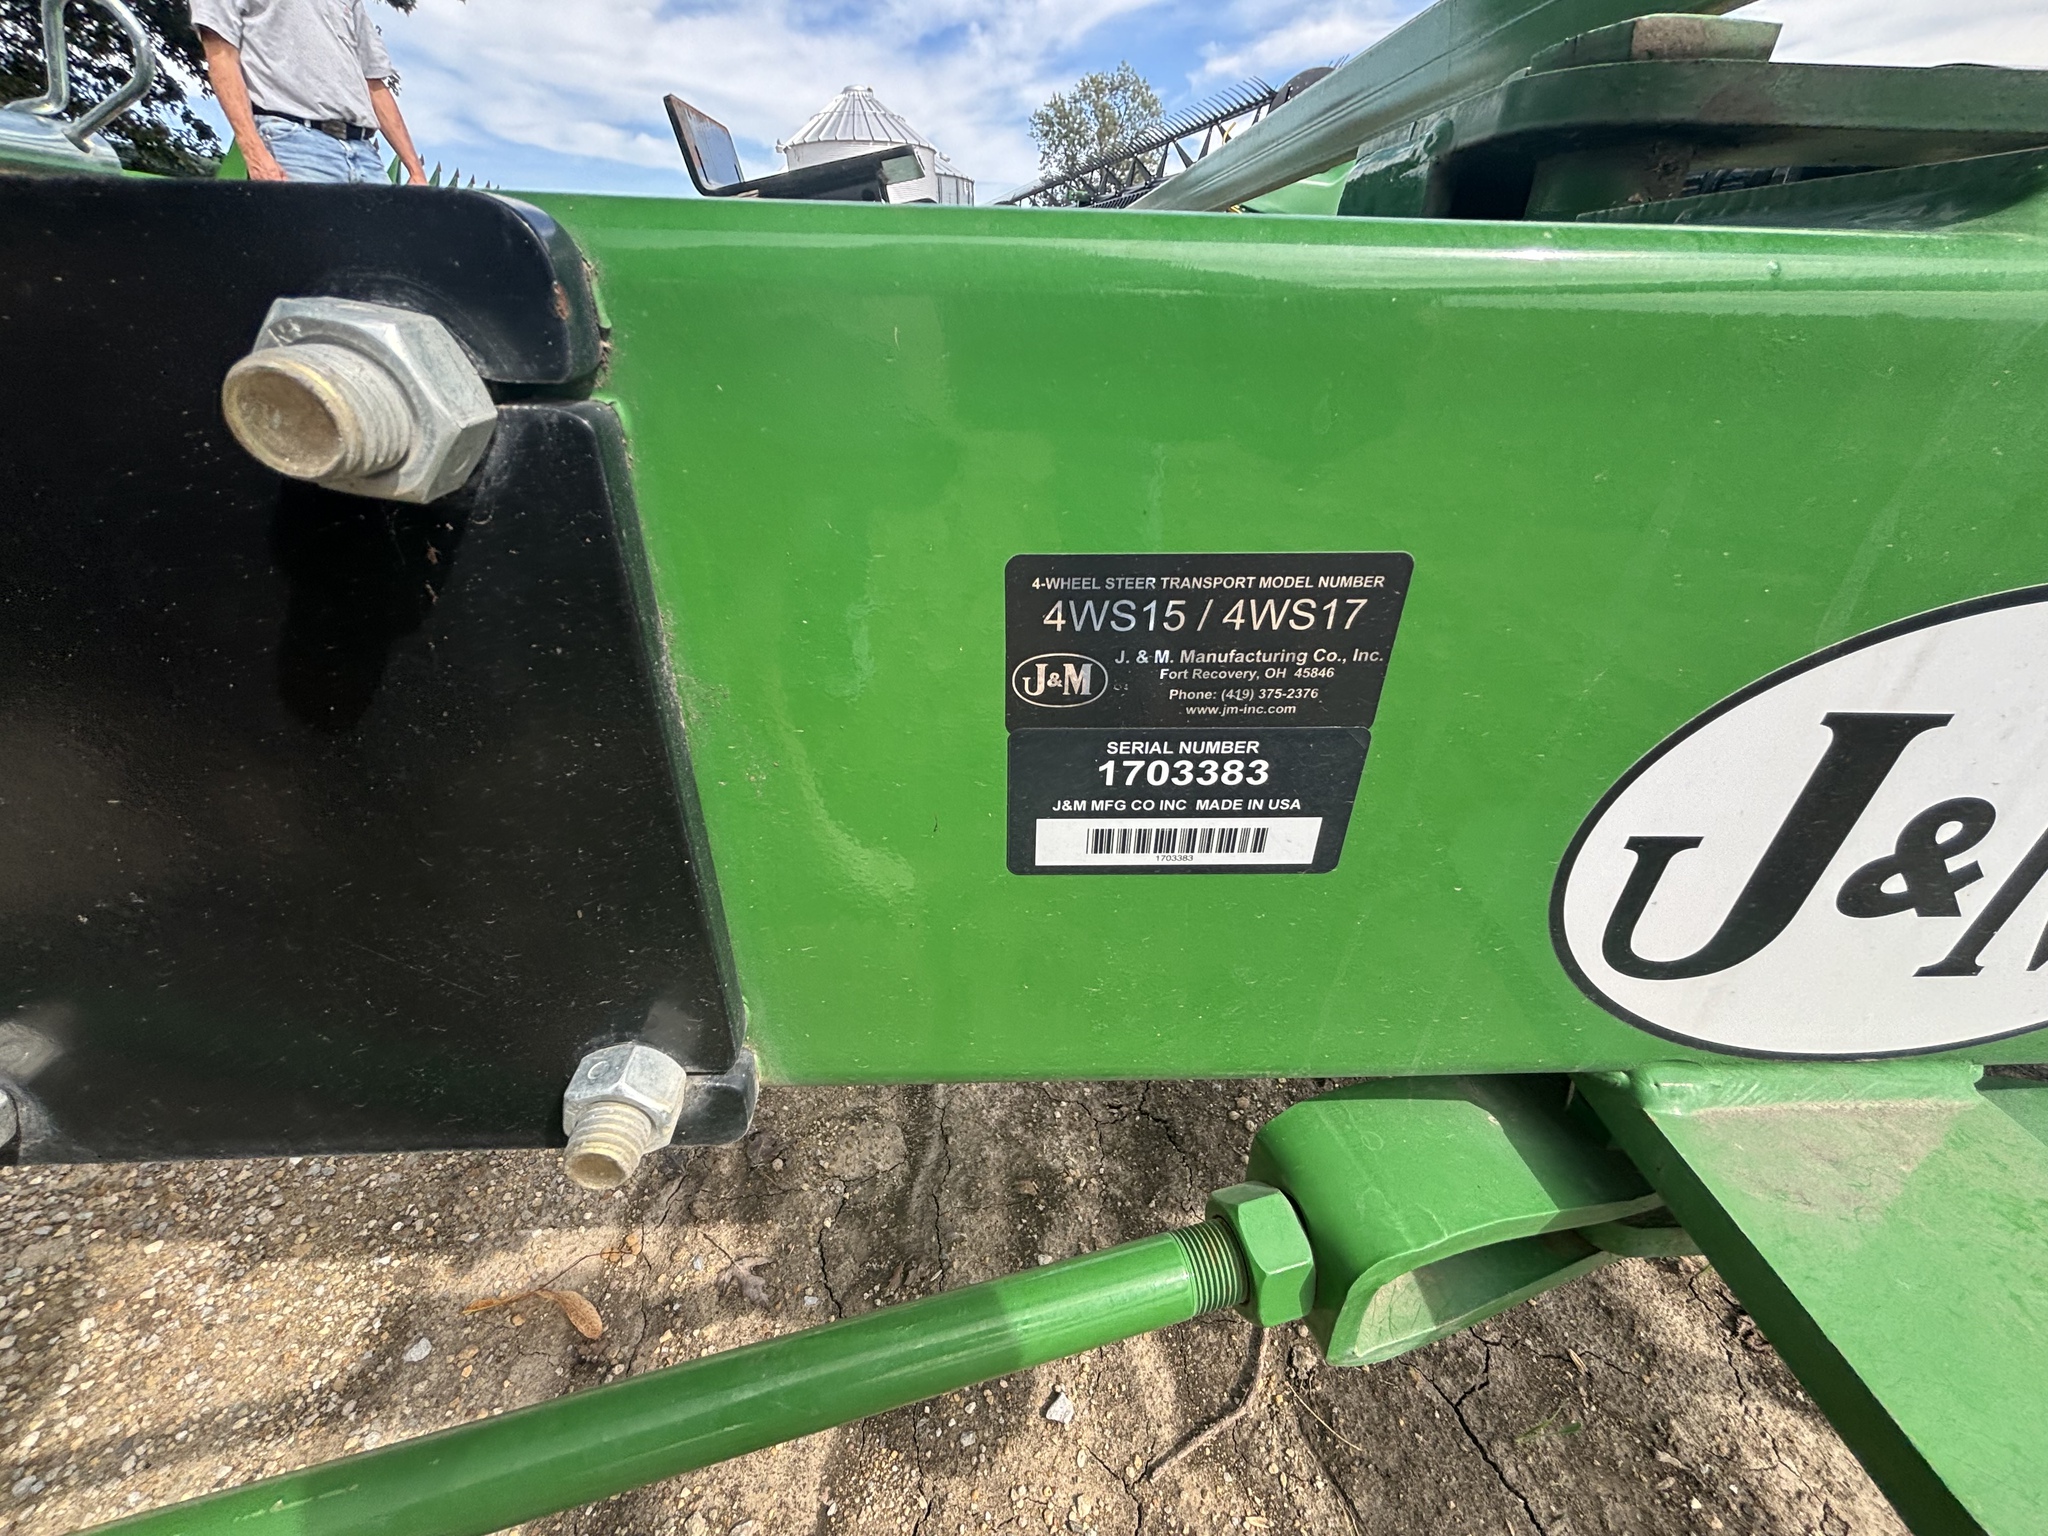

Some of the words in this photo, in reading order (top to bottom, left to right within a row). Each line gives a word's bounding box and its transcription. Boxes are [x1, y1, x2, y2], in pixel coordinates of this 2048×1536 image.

[1031, 577, 1101, 590] 4-WHEEL
[1105, 577, 1156, 590] STEER
[1161, 576, 1254, 590] TRANSPORT
[1258, 576, 1315, 589] MODEL
[1318, 575, 1385, 589] NUMBER
[1042, 600, 1187, 632] 4WS15
[1196, 598, 1213, 632] /
[1222, 599, 1368, 631] 4WS17
[1114, 650, 1130, 664] J.
[1136, 650, 1150, 664] &
[1154, 649, 1175, 664] M.
[1179, 649, 1308, 666] Manufacturing
[1313, 648, 1348, 665] Co.,
[1353, 648, 1384, 663] Inc.
[1022, 663, 1094, 696] J&M
[1159, 668, 1189, 681] Fort
[1192, 667, 1261, 682] Recovery,
[1264, 667, 1287, 680] OH
[1294, 666, 1335, 679] 45846
[1169, 689, 1218, 701] Phone:
[1220, 688, 1255, 702] (419)
[1258, 687, 1319, 700] 375-2376
[1185, 703, 1297, 717] www.jm-inc.com
[1106, 741, 1174, 755] SERIAL
[1178, 740, 1260, 755] NUMBER
[1098, 759, 1269, 786] 1703383
[1052, 800, 1087, 812] J&M
[1090, 800, 1128, 812] MFG
[1130, 800, 1156, 812] CO
[1159, 799, 1188, 812] INC
[1195, 799, 1244, 812] MADE
[1247, 799, 1265, 811] IN
[1267, 798, 1302, 811] USA
[1155, 854, 1194, 862] 1703383
